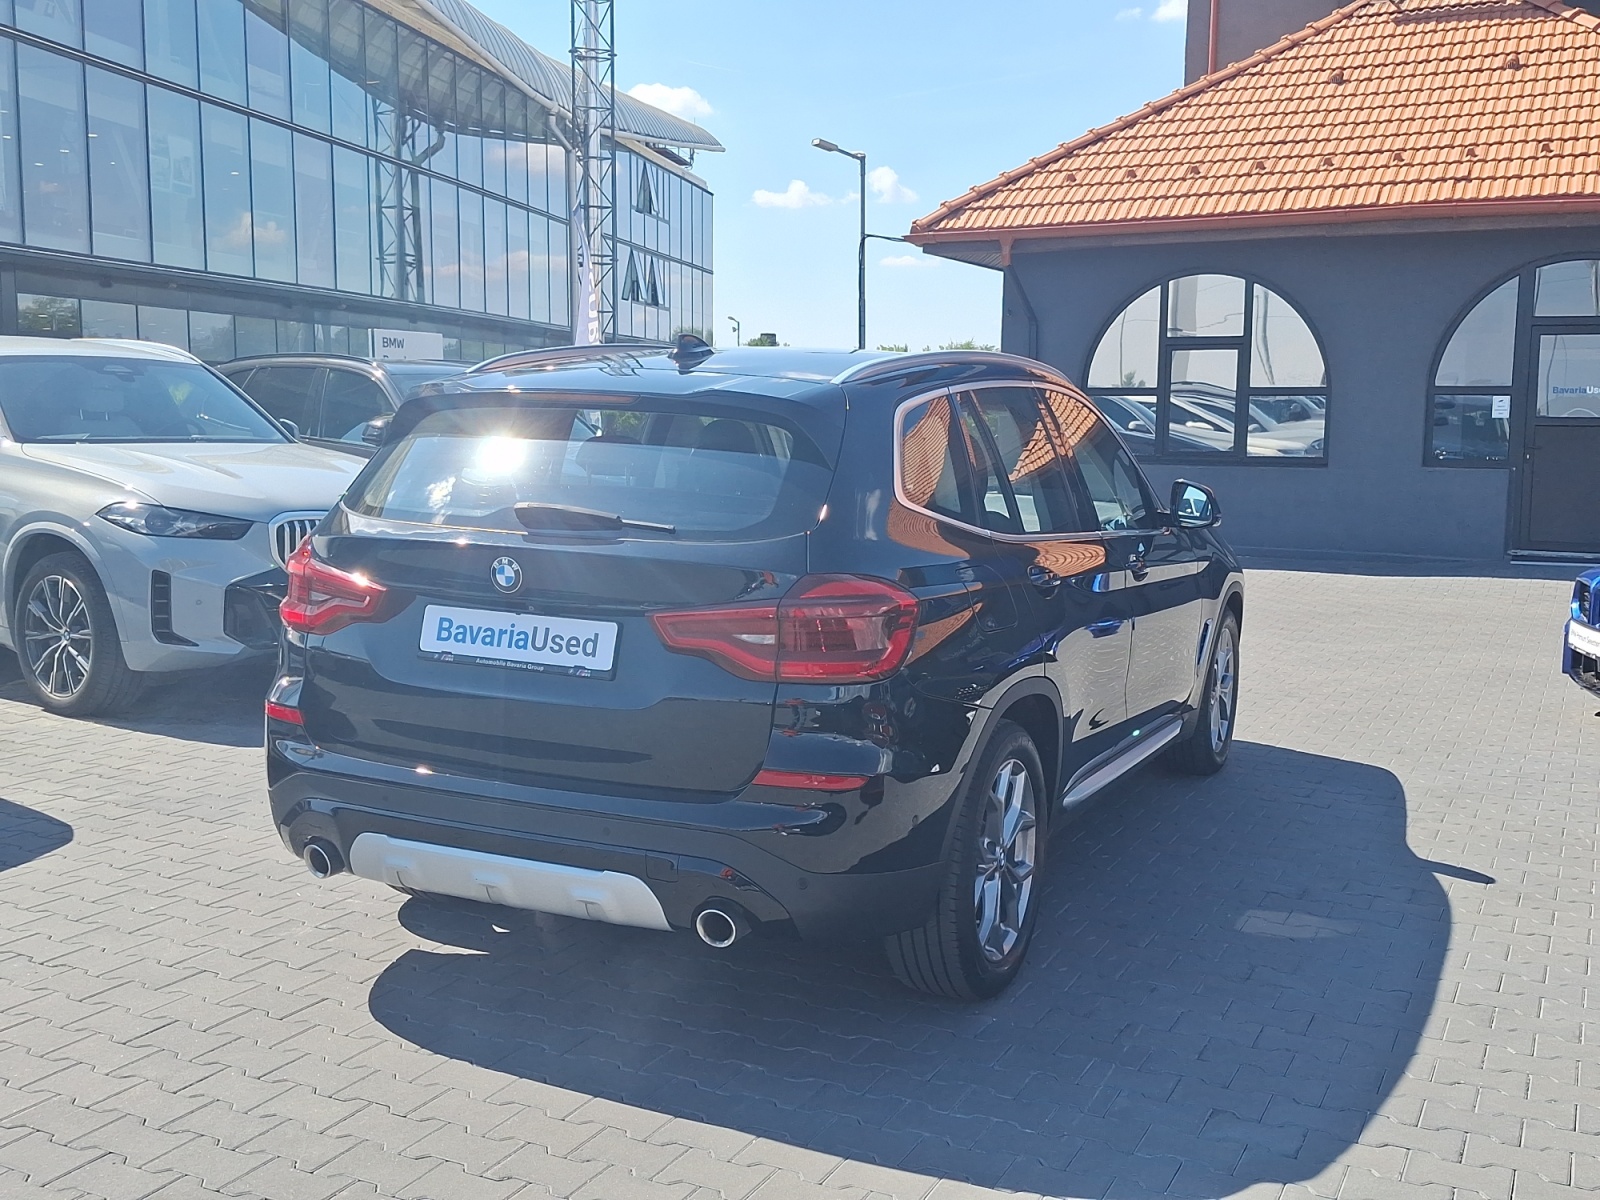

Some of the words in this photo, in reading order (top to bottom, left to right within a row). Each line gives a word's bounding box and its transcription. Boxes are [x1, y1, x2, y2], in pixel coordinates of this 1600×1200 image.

[382, 336, 405, 349] BMW
[1552, 386, 1600, 394] BavariaUs
[436, 616, 600, 658] BavariaUsed
[475, 658, 506, 667] Automobile
[506, 661, 527, 669] Bavaria
[527, 664, 544, 672] Group
